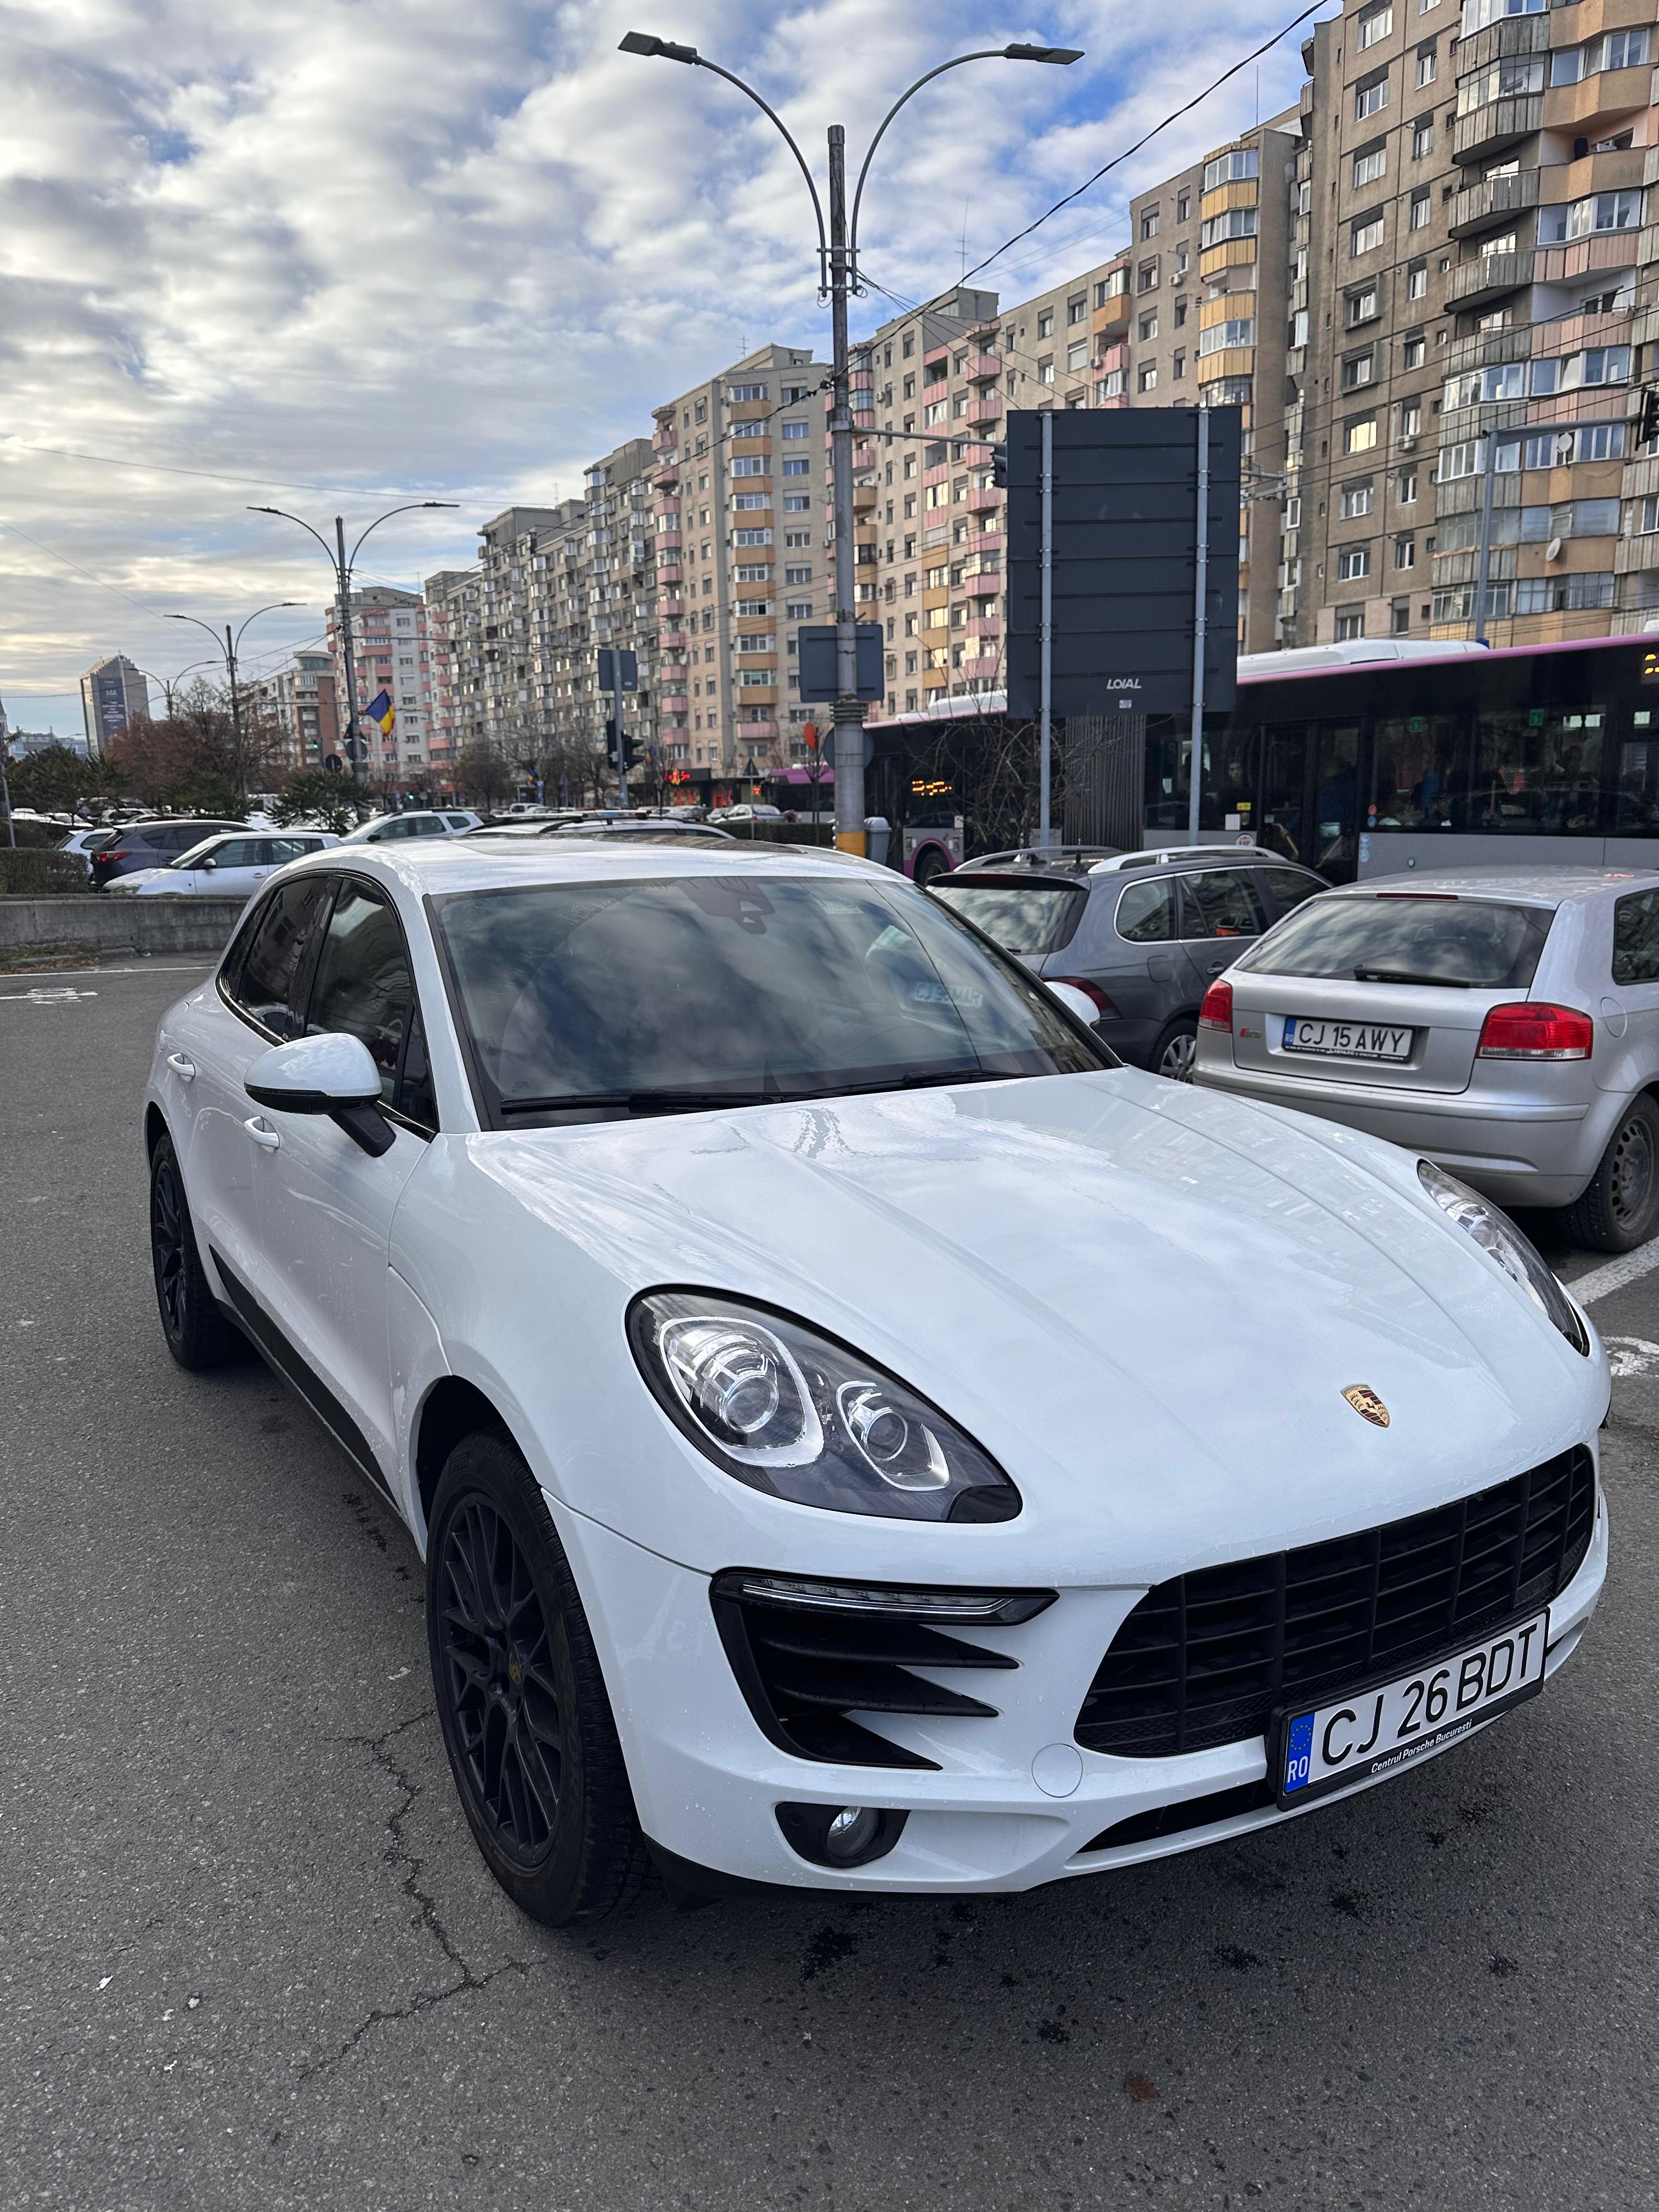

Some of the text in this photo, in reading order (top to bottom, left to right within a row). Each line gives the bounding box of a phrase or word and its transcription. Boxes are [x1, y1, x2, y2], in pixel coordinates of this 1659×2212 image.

[1107, 679, 1142, 689] LOIAL
[1285, 1033, 1294, 1042] RO
[1299, 1023, 1405, 1053] CJ 15 AWY
[1322, 1622, 1537, 1765] CJ 26 BDT
[1372, 1719, 1472, 1774] Centrul Porsche Bucuresti
[1287, 1756, 1309, 1783] RO
